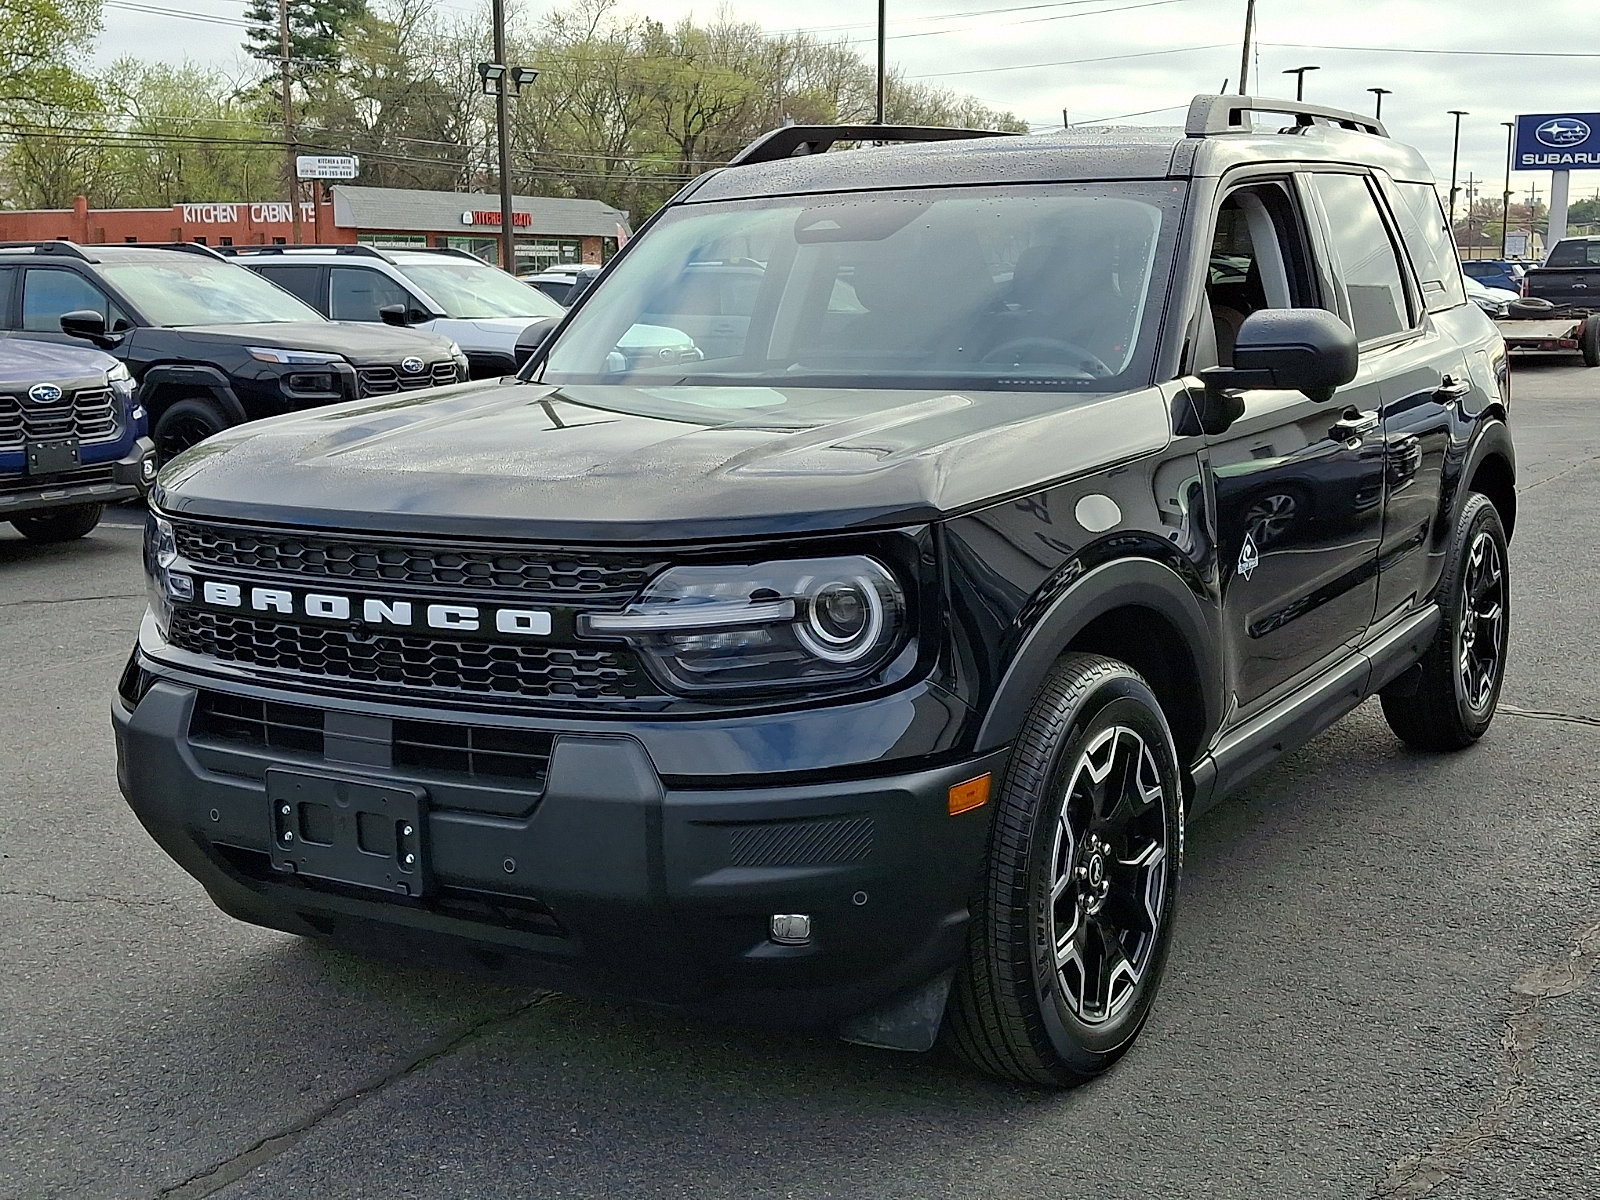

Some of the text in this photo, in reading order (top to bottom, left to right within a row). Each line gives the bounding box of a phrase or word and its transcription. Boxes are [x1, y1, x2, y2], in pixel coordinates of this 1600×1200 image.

[1522, 153, 1600, 165] SUBARU
[183, 205, 316, 223] KITCHEN CABINTS
[473, 211, 503, 225] KITCHE
[203, 581, 552, 636] BRONCO
